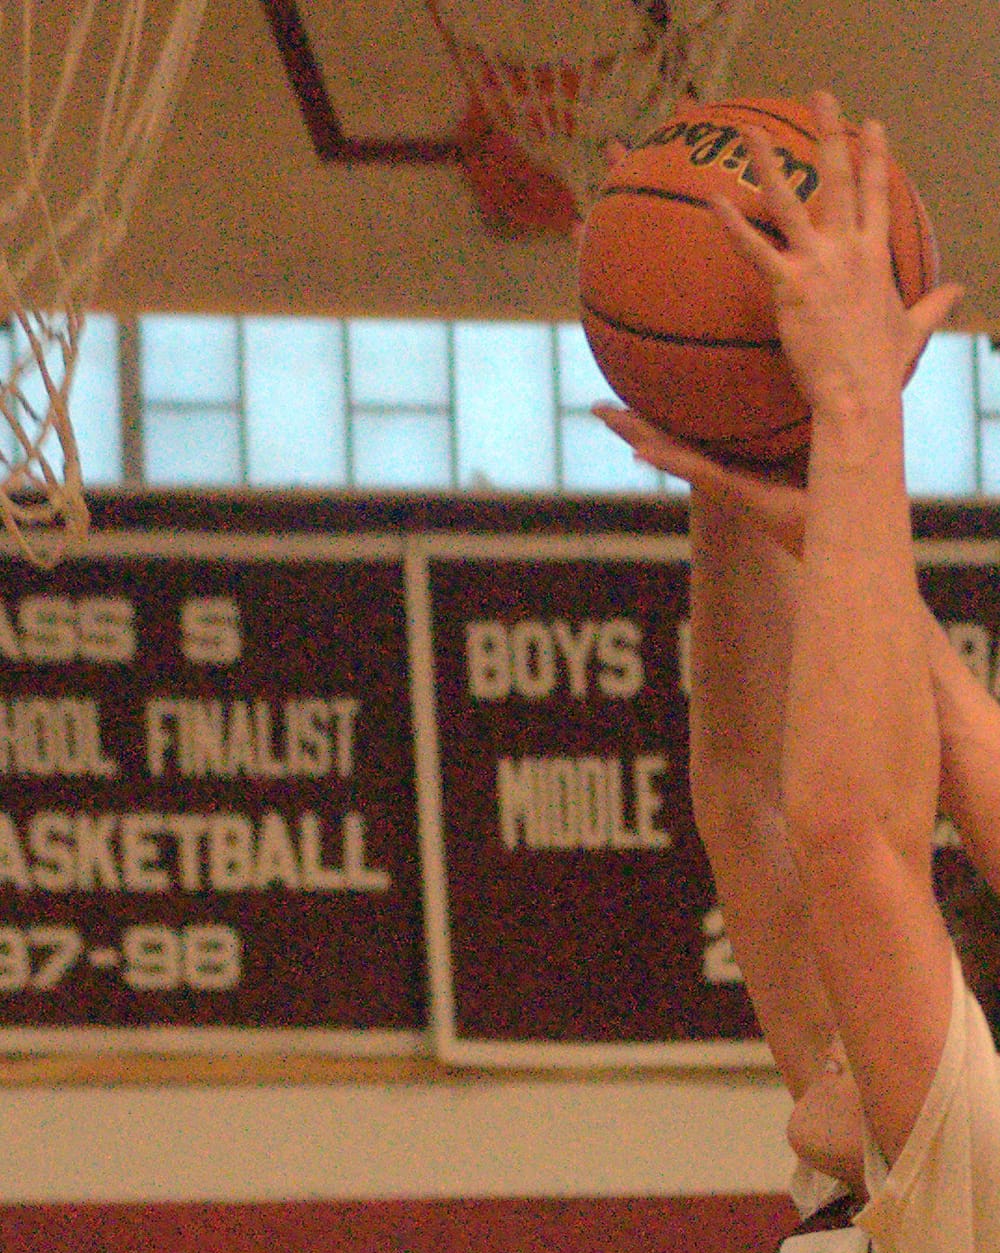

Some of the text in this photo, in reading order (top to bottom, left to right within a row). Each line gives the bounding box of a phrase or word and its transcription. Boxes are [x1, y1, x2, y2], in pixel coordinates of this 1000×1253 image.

[466, 617, 646, 700] BOYS
[146, 698, 360, 778] FINALIST
[498, 755, 671, 851] MIDDLE
